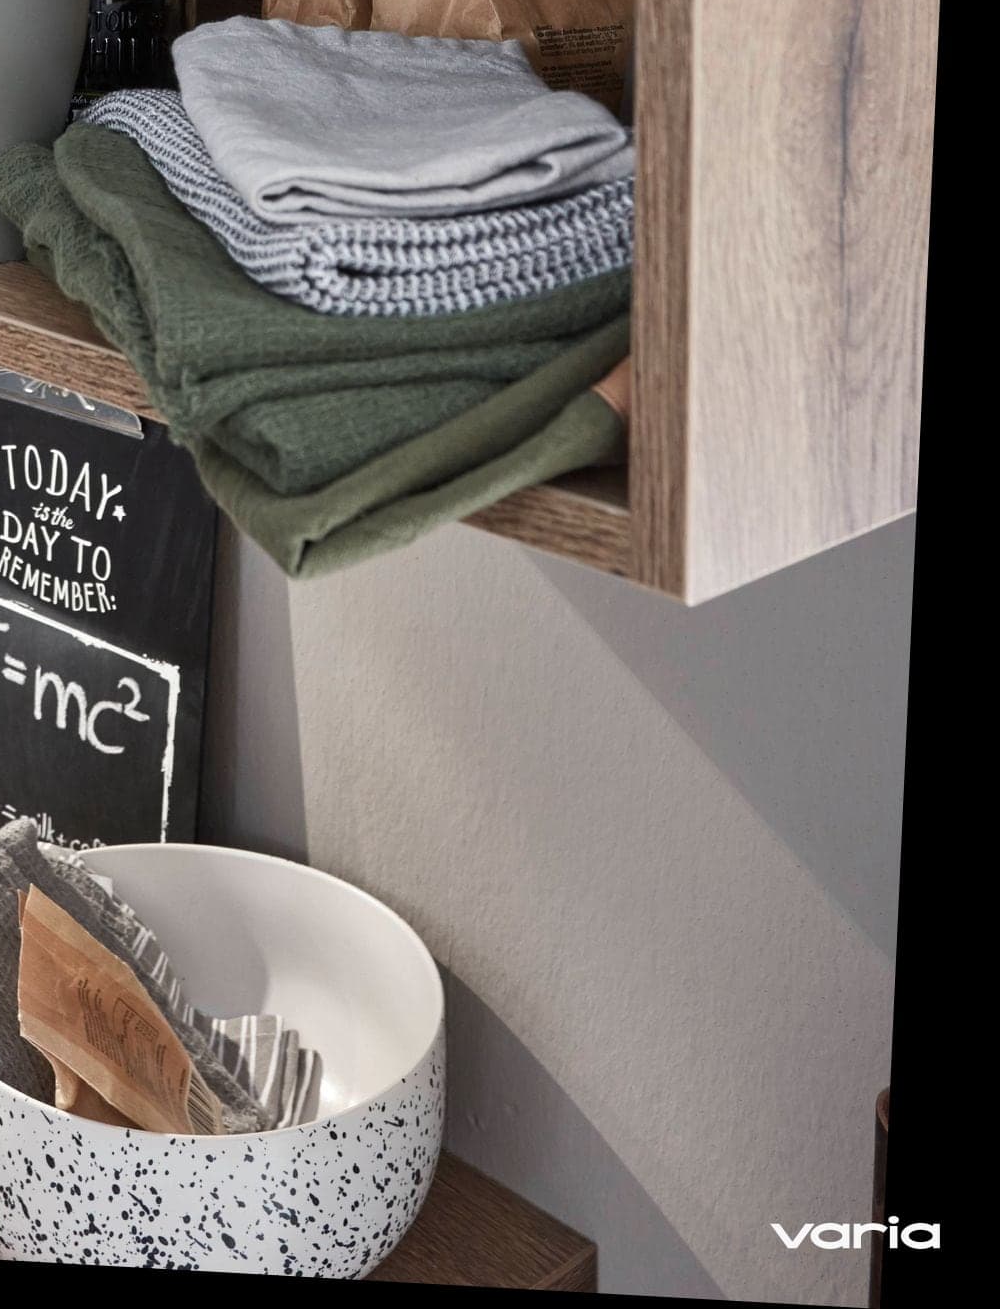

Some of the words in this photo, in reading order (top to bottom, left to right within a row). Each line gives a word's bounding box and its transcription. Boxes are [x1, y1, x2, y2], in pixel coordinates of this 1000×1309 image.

[1, 444, 123, 521] TODAY
[32, 502, 50, 522] is
[50, 505, 75, 531] the
[0, 510, 61, 562] DAY
[70, 535, 111, 582] TO
